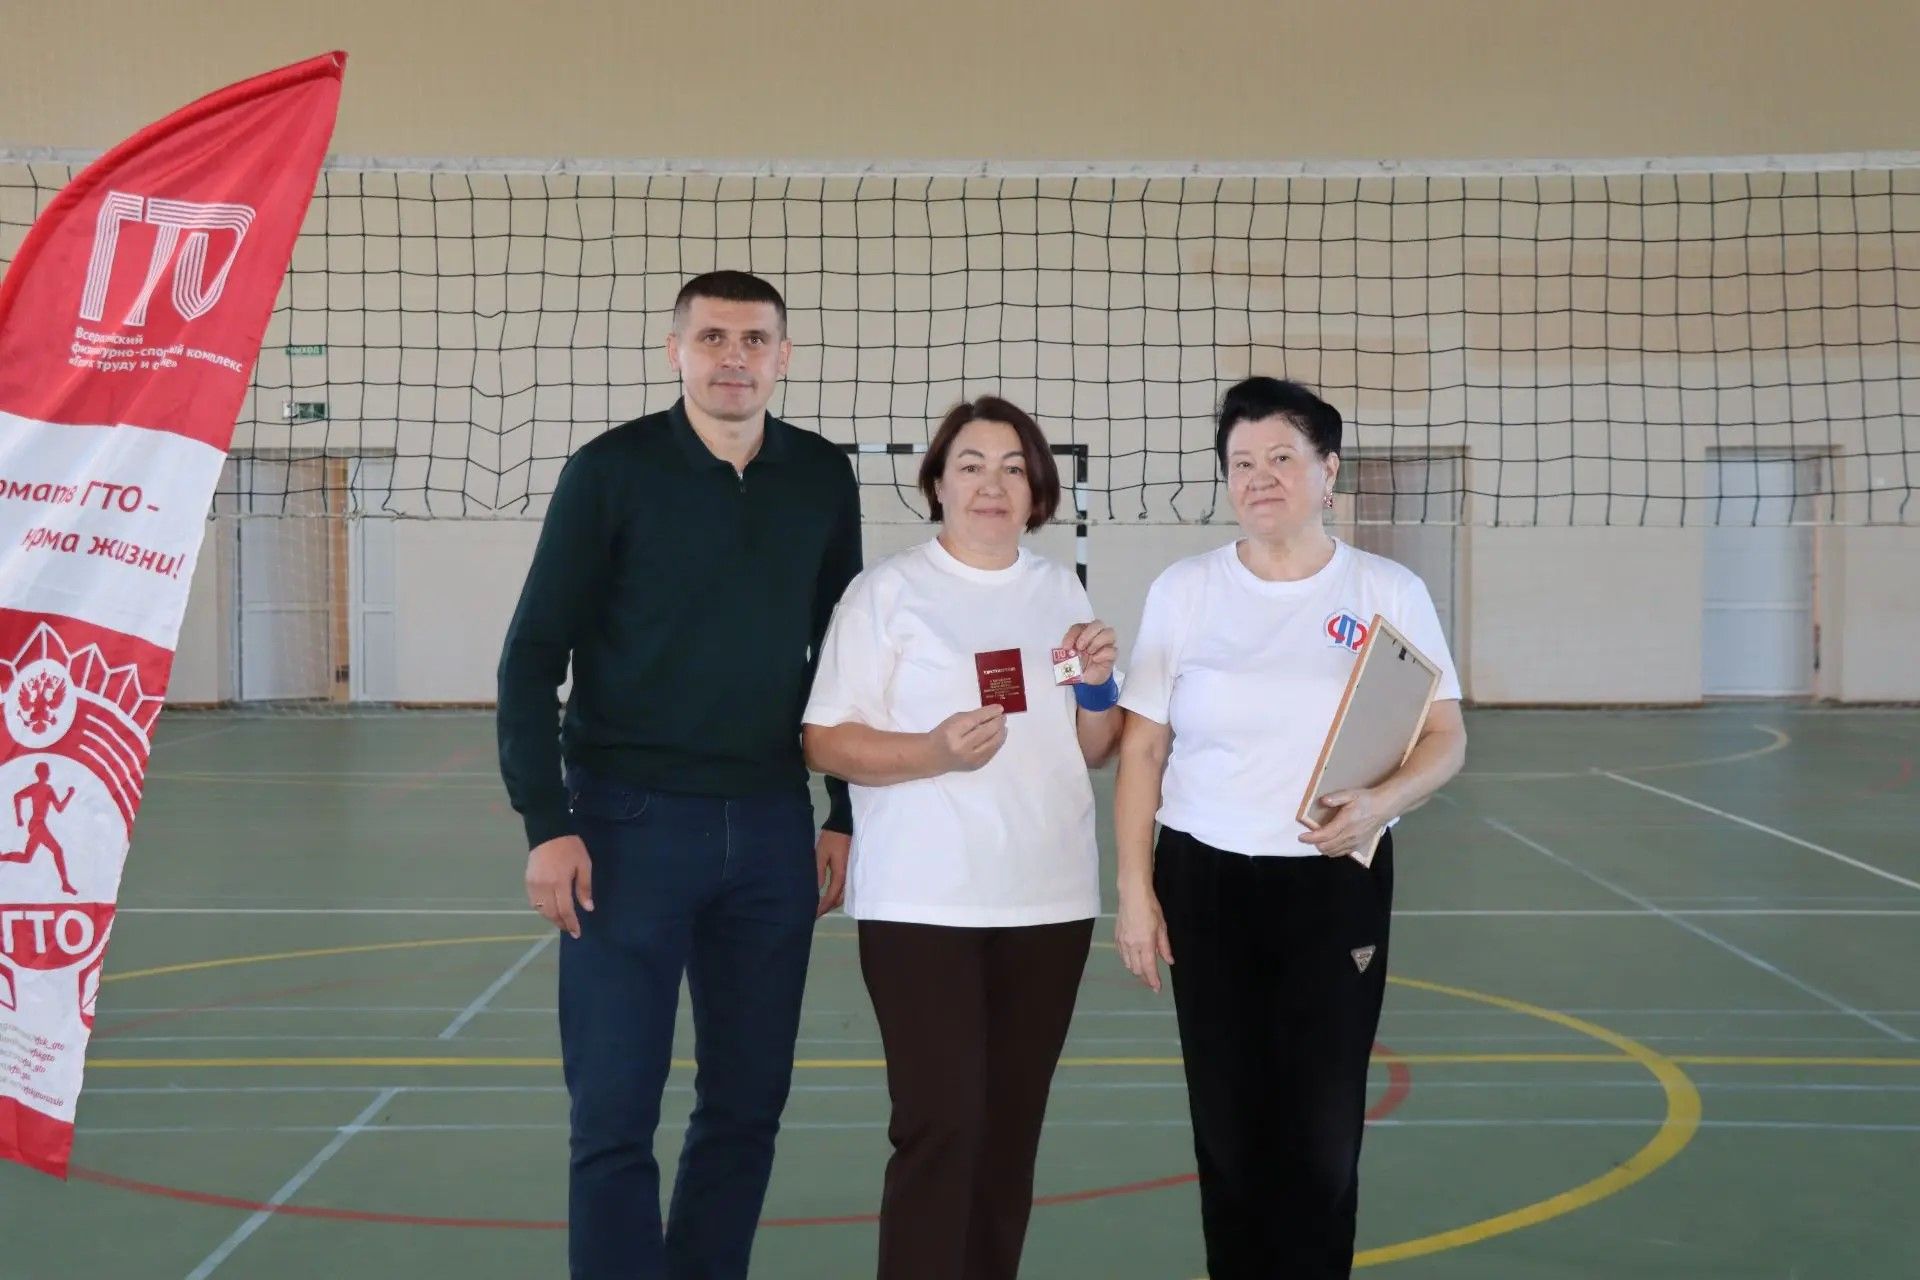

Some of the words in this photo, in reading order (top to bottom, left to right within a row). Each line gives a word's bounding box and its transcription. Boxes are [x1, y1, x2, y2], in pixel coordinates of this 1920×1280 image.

[79, 190, 256, 327] ГТО
[97, 360, 137, 372] труду
[186, 348, 243, 373] комплекс
[80, 480, 143, 513] ГТО
[87, 535, 185, 580] жизни!
[1, 909, 95, 955] ГТО
